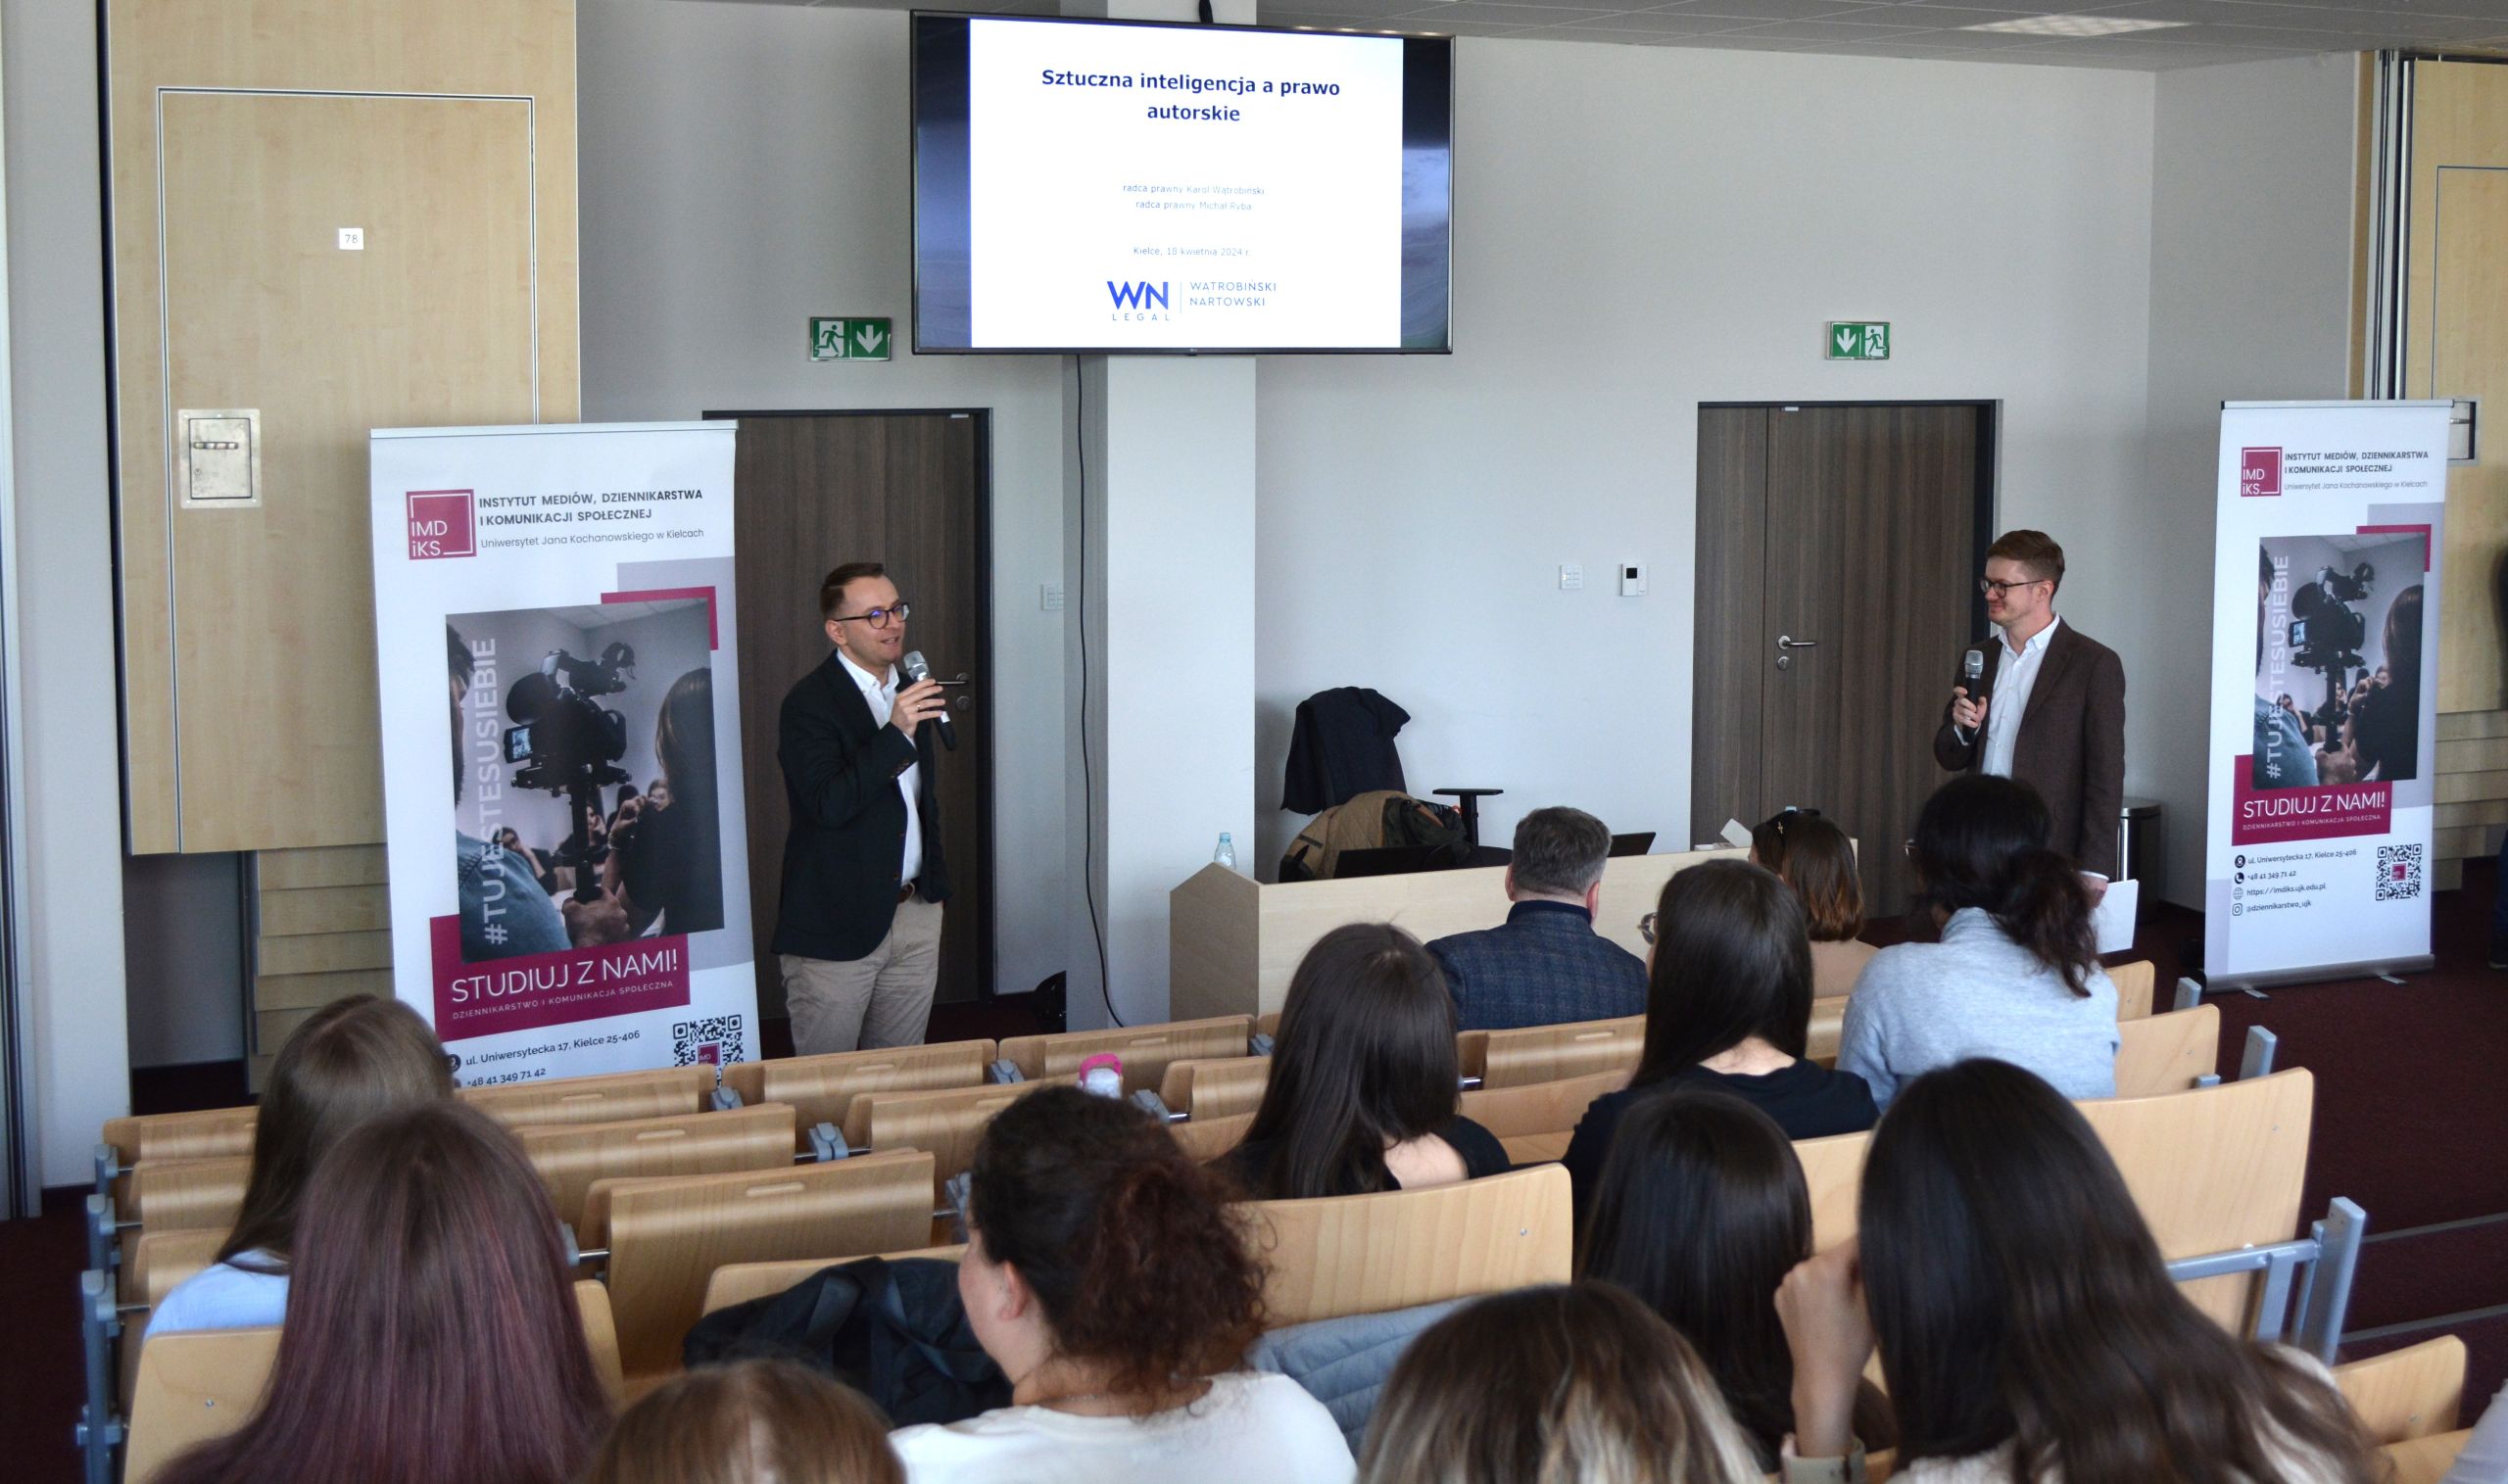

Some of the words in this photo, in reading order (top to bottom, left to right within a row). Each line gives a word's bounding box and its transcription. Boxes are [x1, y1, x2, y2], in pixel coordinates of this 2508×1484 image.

[1041, 70, 1133, 88] Sztuczna
[1140, 72, 1256, 95] inteligencja
[1263, 79, 1273, 93] a
[1280, 79, 1340, 97] prawo
[1147, 105, 1240, 121] autorskie
[1123, 184, 1148, 193] radca
[1151, 185, 1183, 194] prawny
[1186, 185, 1209, 194] Karol
[1164, 202, 1195, 211] prawny
[1200, 201, 1228, 210] Michał
[1230, 202, 1252, 212] Ryba
[345, 234, 359, 244] 78
[1133, 247, 1163, 257] Kielce,
[1181, 247, 1218, 256] kwietnia
[1221, 248, 1242, 257] 2024
[1106, 280, 1169, 310] WN
[1189, 297, 1265, 307] NARTOWSKI
[1112, 312, 1170, 321] LEGAL
[2285, 453, 2321, 461] INSTYTUT
[2324, 451, 2359, 461] MEDIÓW,
[2362, 451, 2429, 460] DZIENNIKARSTWA
[2243, 468, 2265, 480] IMD
[2242, 483, 2260, 495] iKS
[2285, 482, 2321, 492] Uniwersytet
[2339, 480, 2393, 491] Kochanowskiego
[479, 496, 537, 508] INSTYTUT
[542, 492, 598, 506] MEDIÓW,
[602, 489, 703, 503] DZIENNIKARSTWA
[486, 511, 573, 526] KOMUNIKACJI
[578, 508, 652, 522] SPOŁECZNEJ
[410, 520, 448, 537] IMD
[481, 536, 540, 550] Uniwersytet
[542, 534, 568, 546] Jana
[570, 530, 654, 546] Kochanowskiego
[666, 528, 704, 539] Kielcach
[411, 541, 441, 557] iKS
[2266, 555, 2290, 780] #TUJESTESUSIEBIE
[472, 638, 508, 945] #TUJESTESUSIEBIE
[2243, 796, 2317, 819] STUDIUJ
[2320, 794, 2332, 812] Z
[2337, 791, 2386, 811] NAMI!
[2243, 819, 2295, 831] DZIENNIKARSTWO
[2302, 816, 2343, 826] KOMUNIKACJA
[2345, 814, 2381, 823] SPOŁECZNA
[2257, 854, 2303, 864] Uniwersytecka
[2268, 871, 2280, 880] 349
[2246, 883, 2326, 896] https://imdiks.ujk.edu.pl
[452, 964, 568, 1003] STUDIUJ
[577, 960, 595, 985] Z
[603, 948, 678, 981] NAMI!
[453, 999, 539, 1020] DZIENNIKARSTWO
[549, 988, 616, 1006] KOMUNIKACJA
[619, 981, 674, 995] SPOŁECZNA
[465, 1054, 479, 1066] ul.
[480, 1043, 555, 1064] Uniwersytecka
[573, 1036, 604, 1049] Kielce
[606, 1029, 641, 1044] 25-406
[467, 1077, 484, 1087] +48
[486, 1076, 498, 1085] 41
[501, 1073, 518, 1083] 349
[520, 1070, 531, 1080] 71
[534, 1068, 546, 1077] 42
